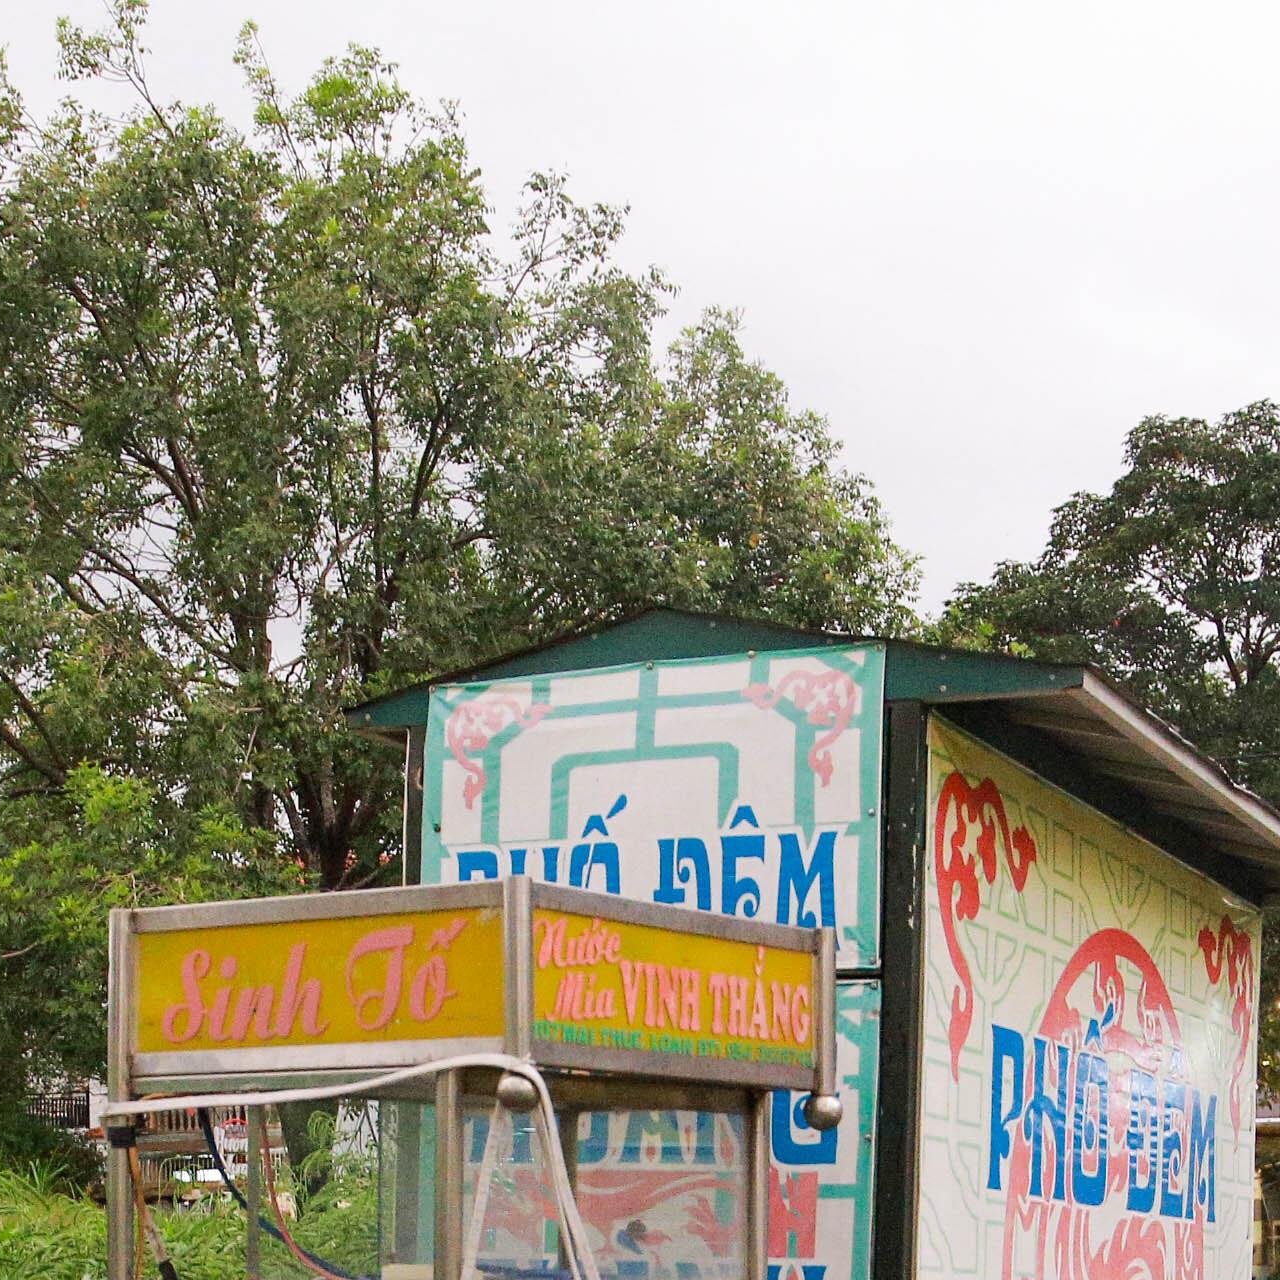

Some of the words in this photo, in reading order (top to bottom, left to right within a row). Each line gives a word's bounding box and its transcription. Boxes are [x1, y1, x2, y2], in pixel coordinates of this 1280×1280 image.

[162, 943, 329, 1044] Sinh
[345, 917, 469, 1031] Tố
[620, 959, 701, 1032] VINH
[986, 1002, 1115, 1206] PHỐ
